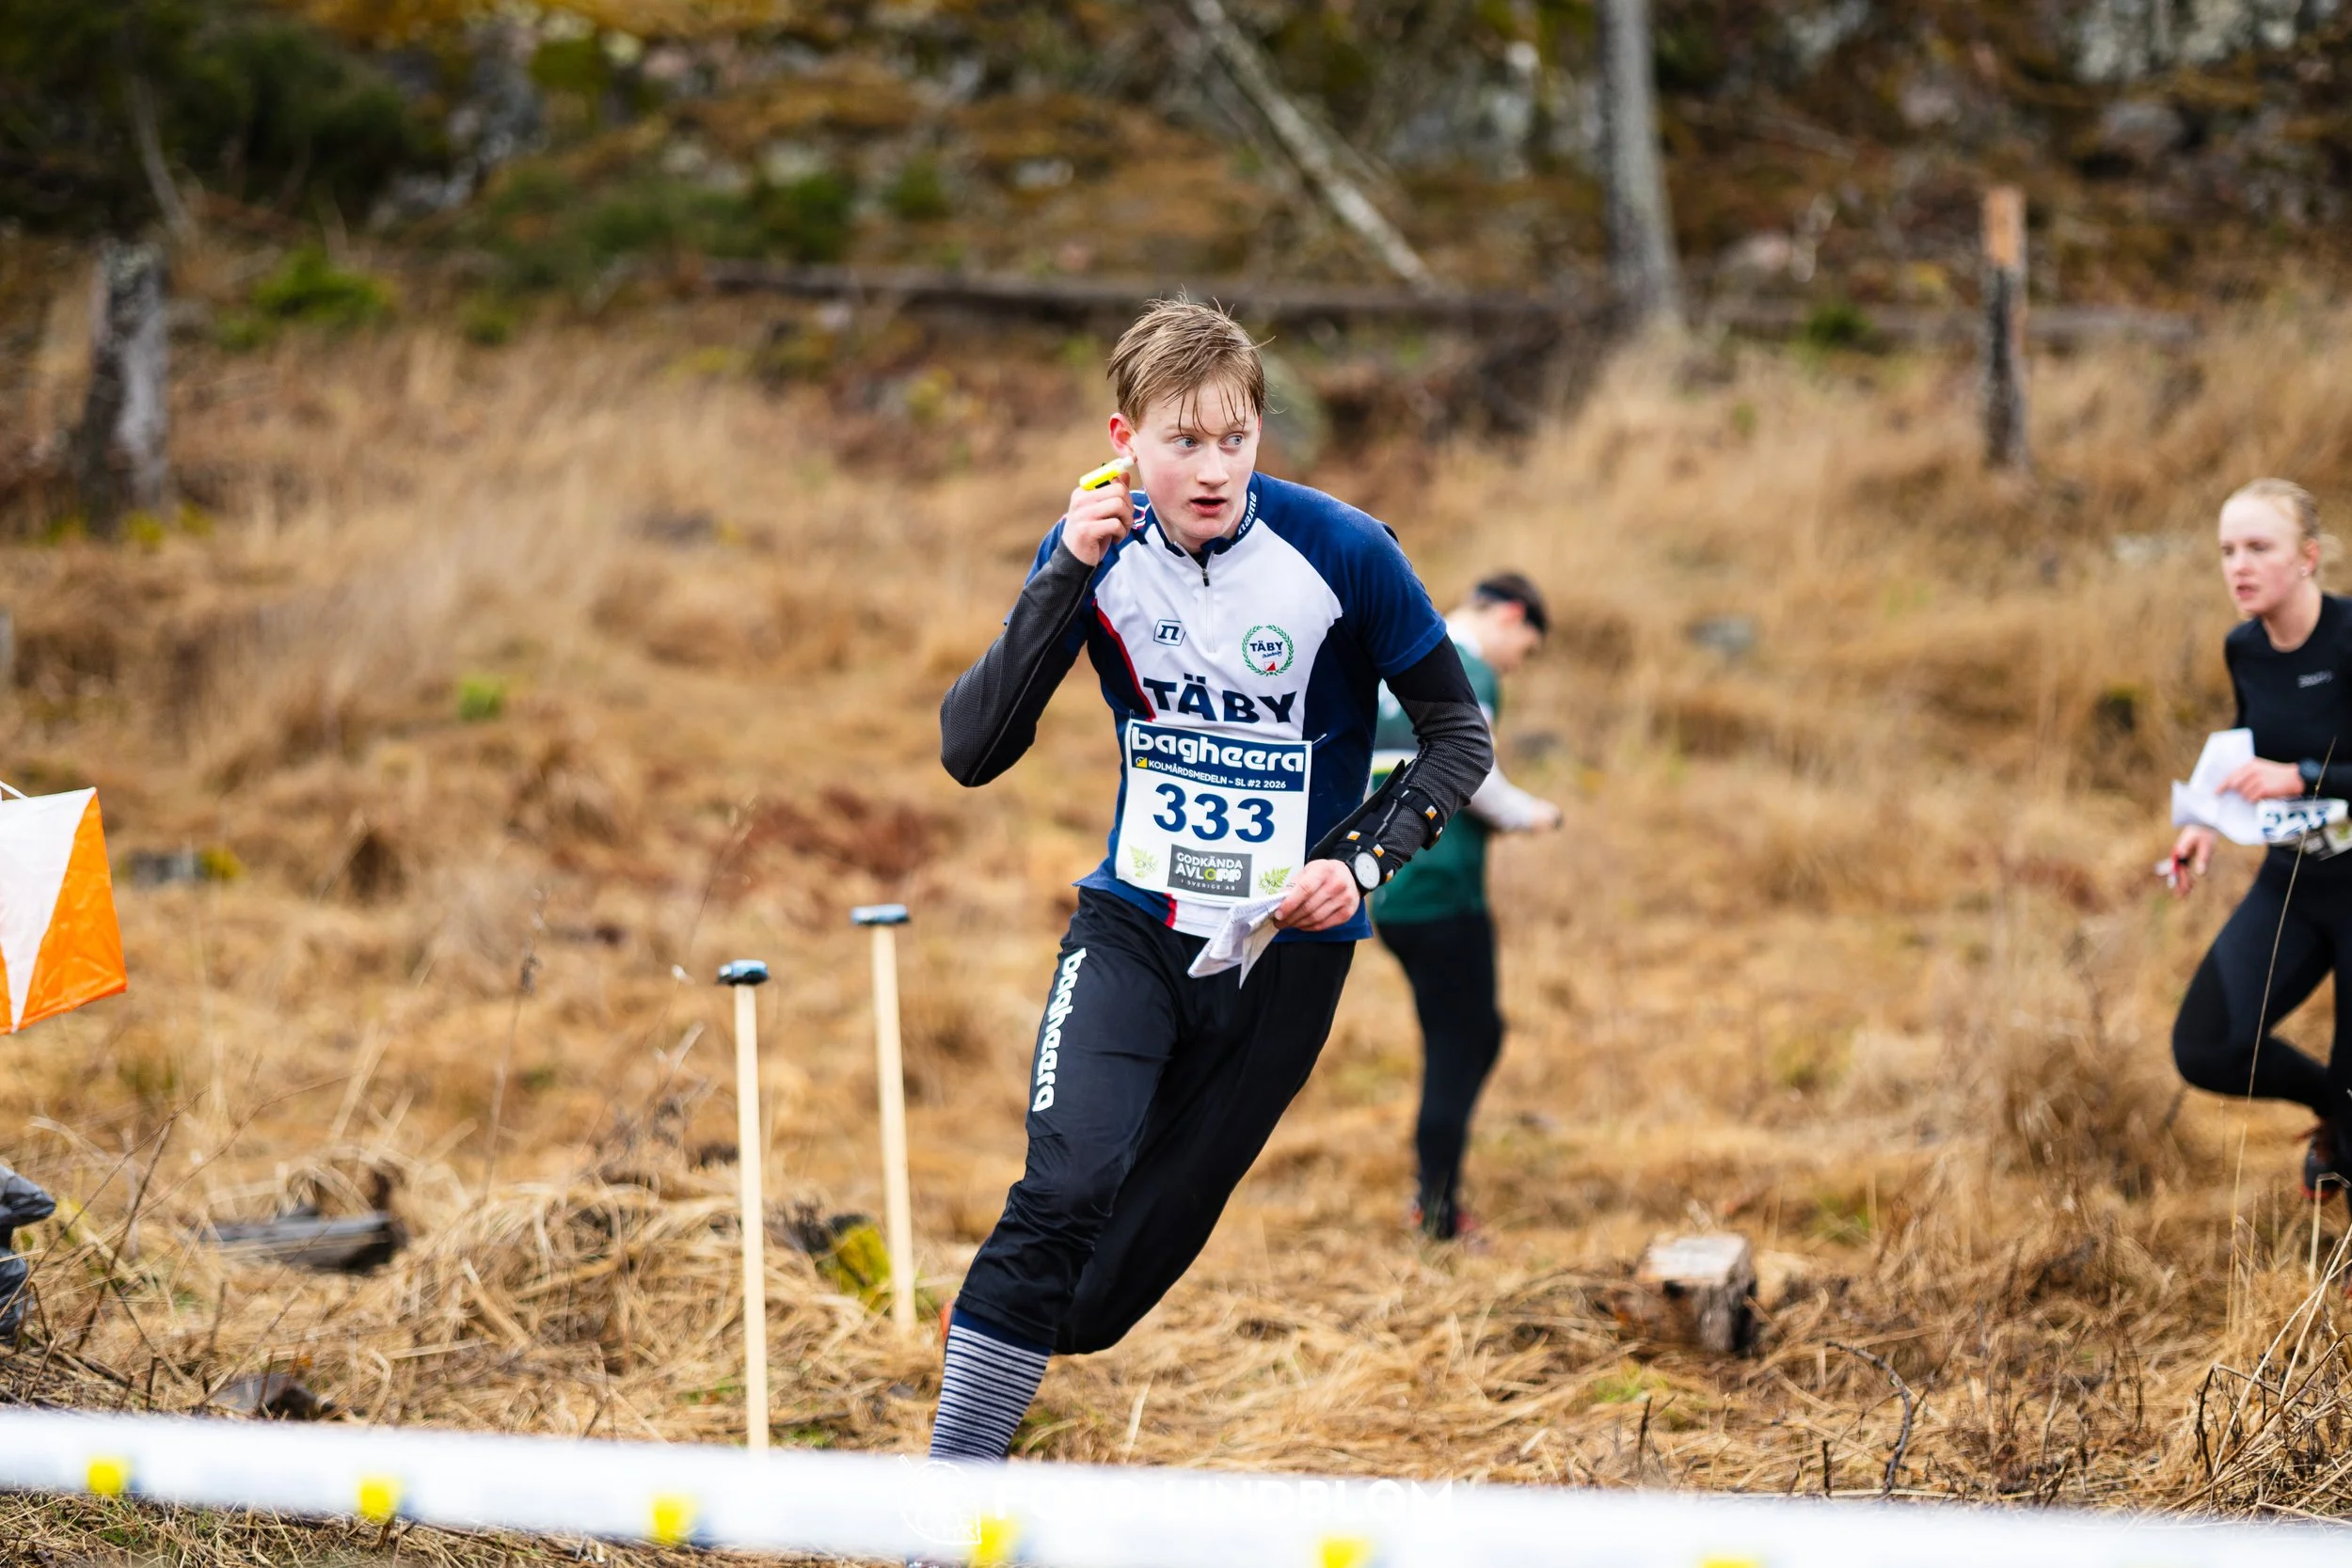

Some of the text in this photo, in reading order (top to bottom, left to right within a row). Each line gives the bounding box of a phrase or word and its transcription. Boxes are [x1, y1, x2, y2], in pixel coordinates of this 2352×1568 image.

[1249, 640, 1283, 652] TÄBY
[1143, 673, 1297, 724] TÄBY
[1132, 727, 1304, 772] bagheera
[1149, 759, 1227, 784] KOLMÅRDSMEDELN
[1235, 778, 1246, 787] SL
[1248, 779, 1261, 787] #2
[1263, 780, 1286, 788] 2026
[1152, 783, 1275, 843] 333
[1176, 852, 1243, 869] GODKÄNDA
[1187, 880, 1221, 890] SVERIGE
[1032, 947, 1088, 1112] bagheera
